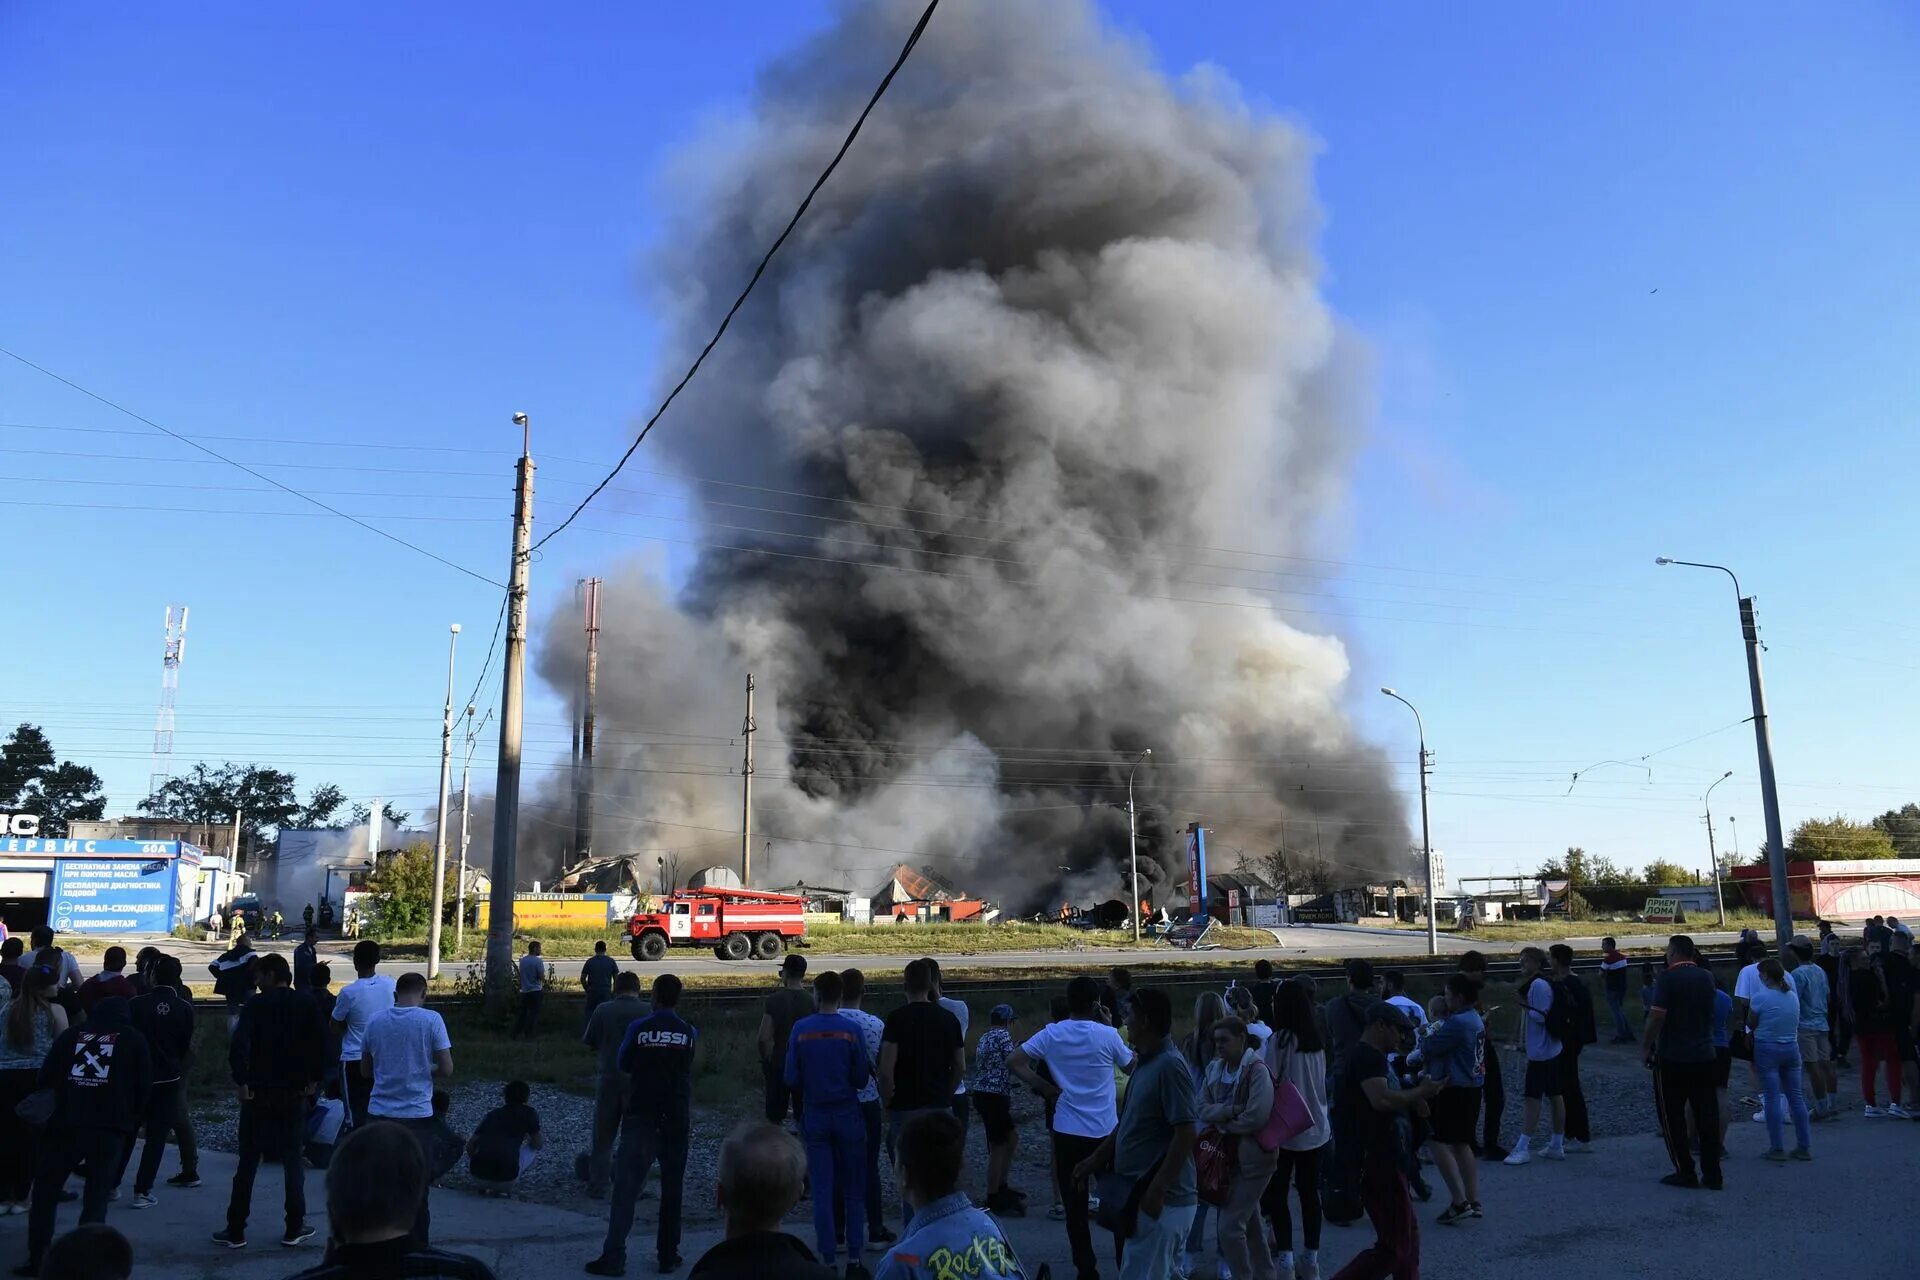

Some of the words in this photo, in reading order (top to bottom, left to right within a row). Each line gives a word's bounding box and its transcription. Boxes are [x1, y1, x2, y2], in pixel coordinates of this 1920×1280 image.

[0, 840, 96, 853] ЕРВИС
[143, 845, 166, 853] 60А
[111, 882, 160, 890] ДИАГНОСТИКА
[74, 904, 166, 914] РАЗВАЛ-СХОЖДЕНИЕ
[73, 920, 138, 929] ШИНОМОНТАЖ
[677, 921, 684, 929] 5
